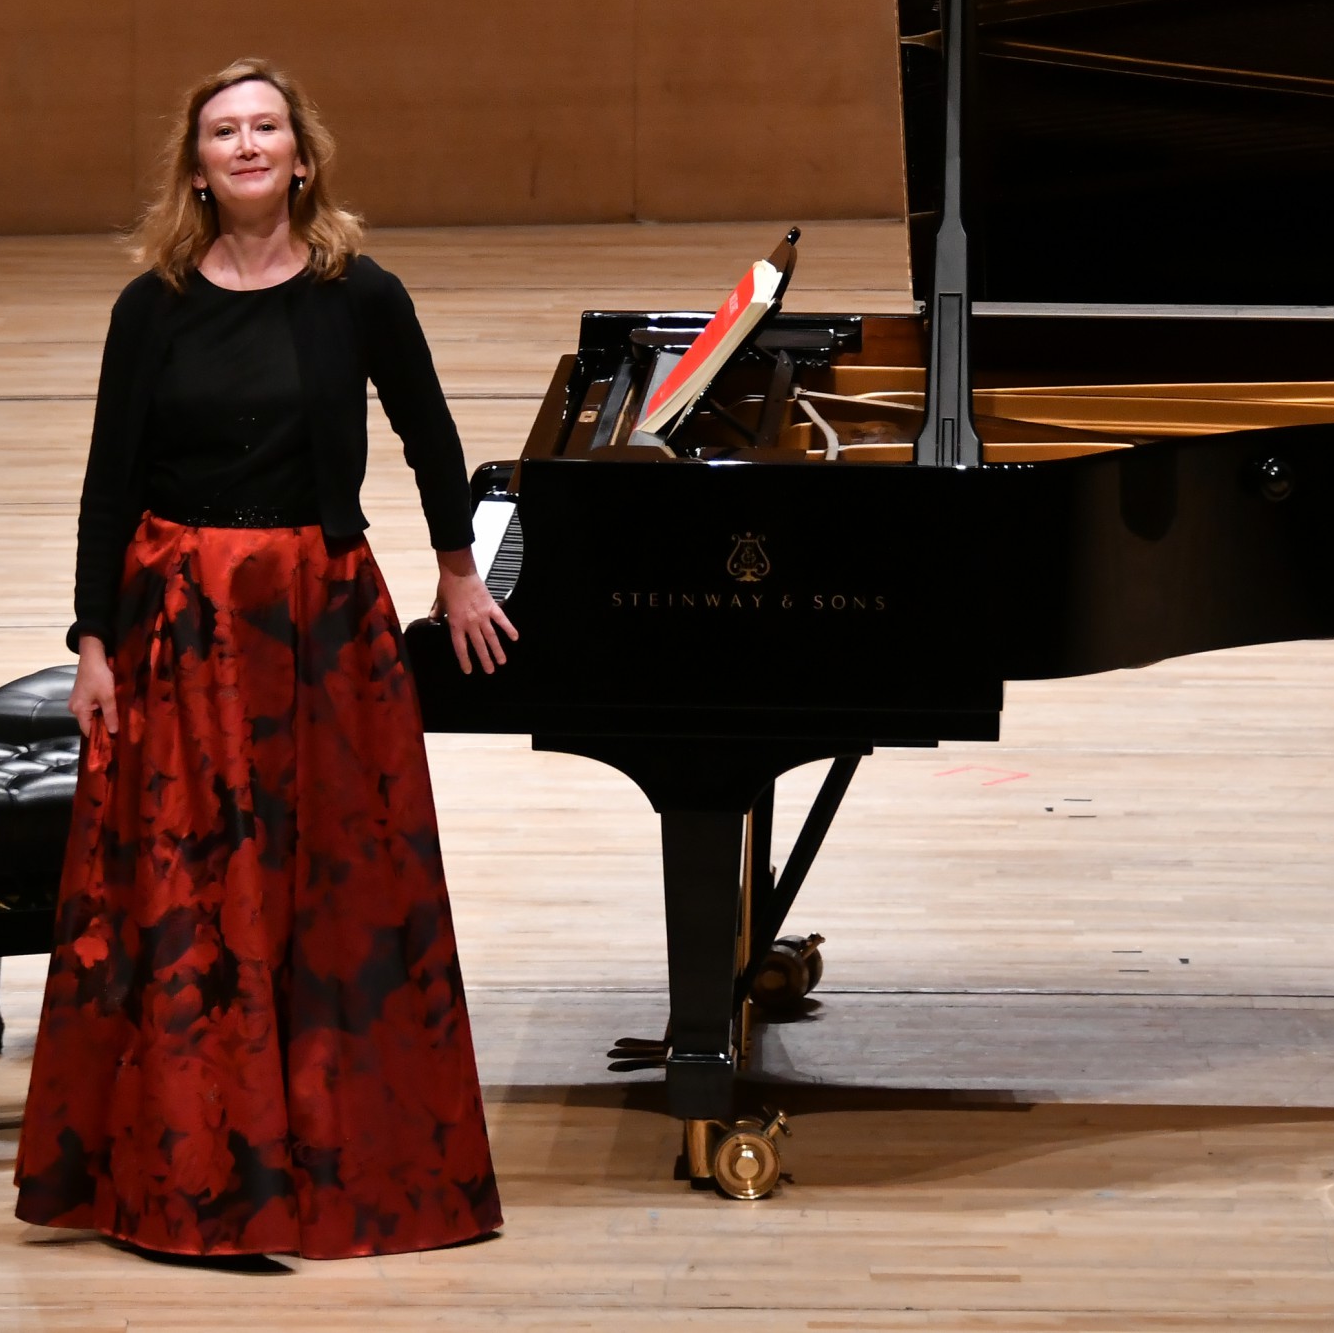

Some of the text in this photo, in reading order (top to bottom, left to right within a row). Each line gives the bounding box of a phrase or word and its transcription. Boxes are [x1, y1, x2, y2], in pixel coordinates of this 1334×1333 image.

[612, 592, 886, 611] STEINWAY & SONS
